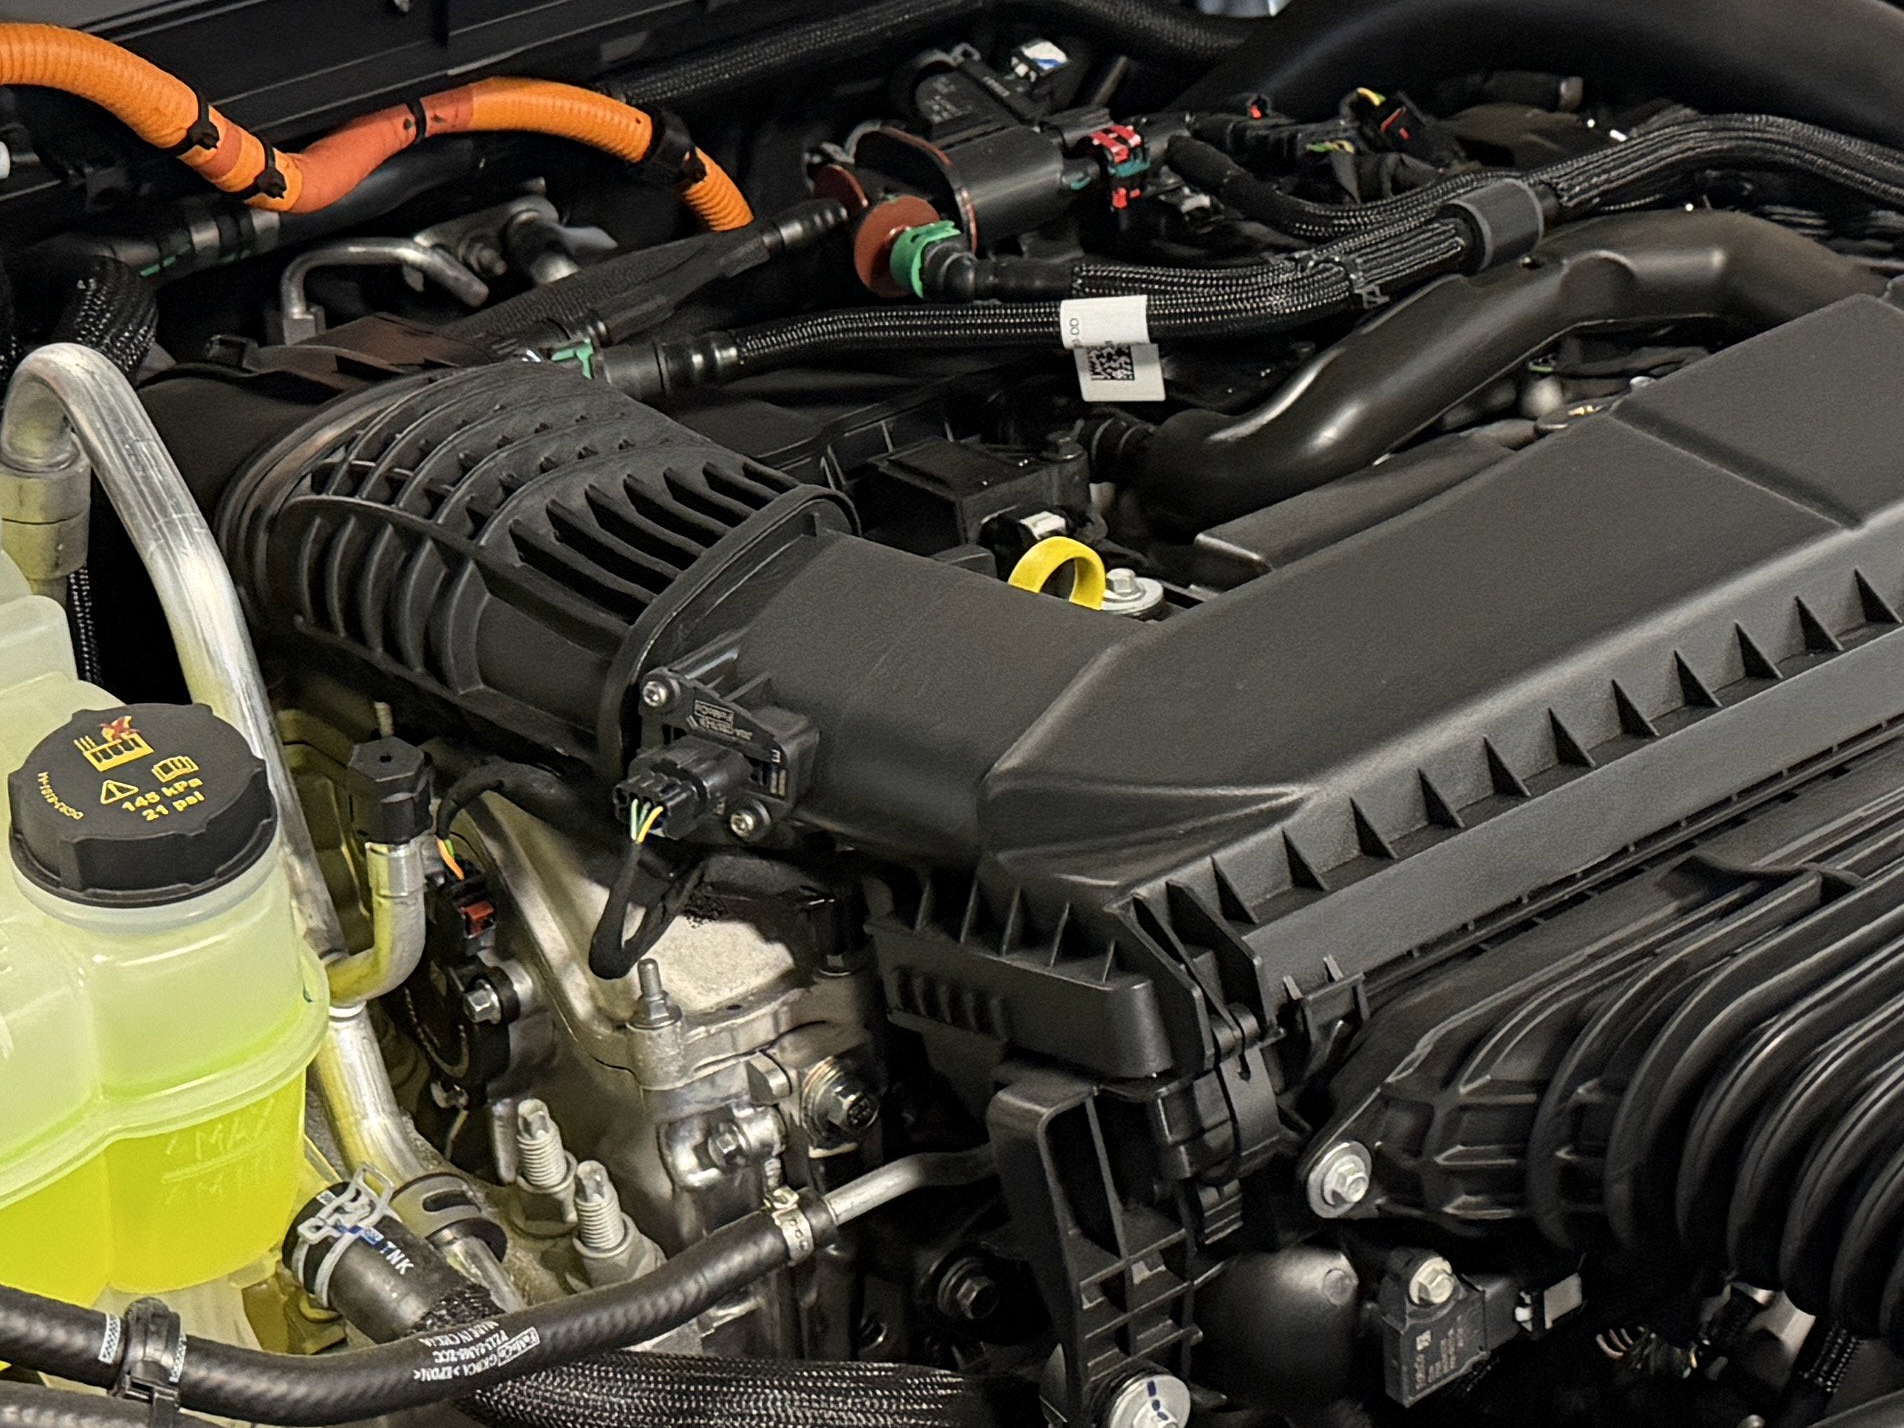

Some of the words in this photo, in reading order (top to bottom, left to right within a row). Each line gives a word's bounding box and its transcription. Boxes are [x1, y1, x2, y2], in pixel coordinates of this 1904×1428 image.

[122, 791, 160, 812] 145
[161, 777, 203, 797] kPa
[142, 805, 169, 821] 21
[172, 791, 205, 812] psi
[380, 1241, 414, 1275] TNK
